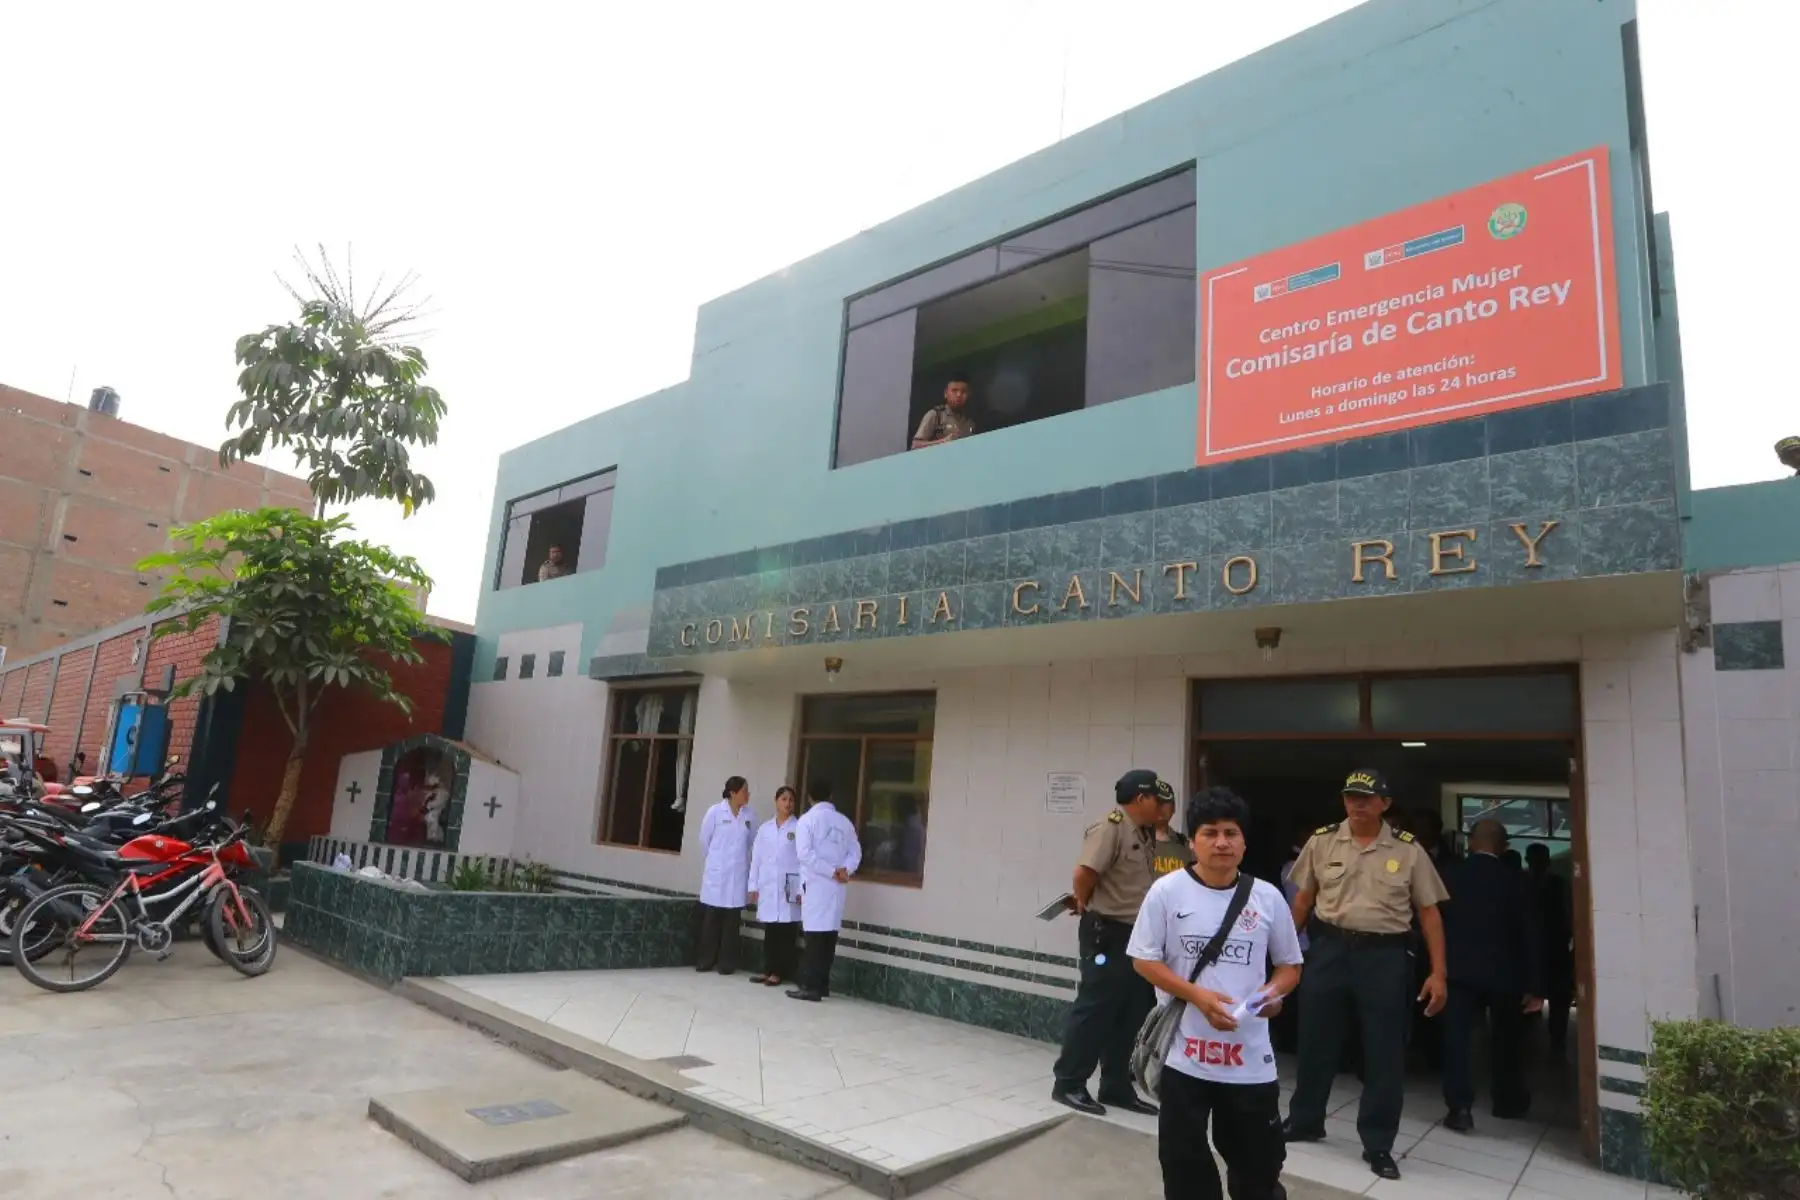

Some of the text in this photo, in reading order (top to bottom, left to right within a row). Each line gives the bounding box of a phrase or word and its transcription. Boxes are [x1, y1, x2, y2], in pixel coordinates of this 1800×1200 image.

[1226, 279, 1572, 379] Comisaría de Canto Rey
[1259, 264, 1523, 343] Centro Emergencia Mujer
[1279, 366, 1517, 424] Lunes a domingo las 24 horas
[1311, 353, 1476, 399] Horario de atención:
[680, 520, 1560, 648] COMISARIA CANTO REY
[1184, 1036, 1244, 1067] FISK
